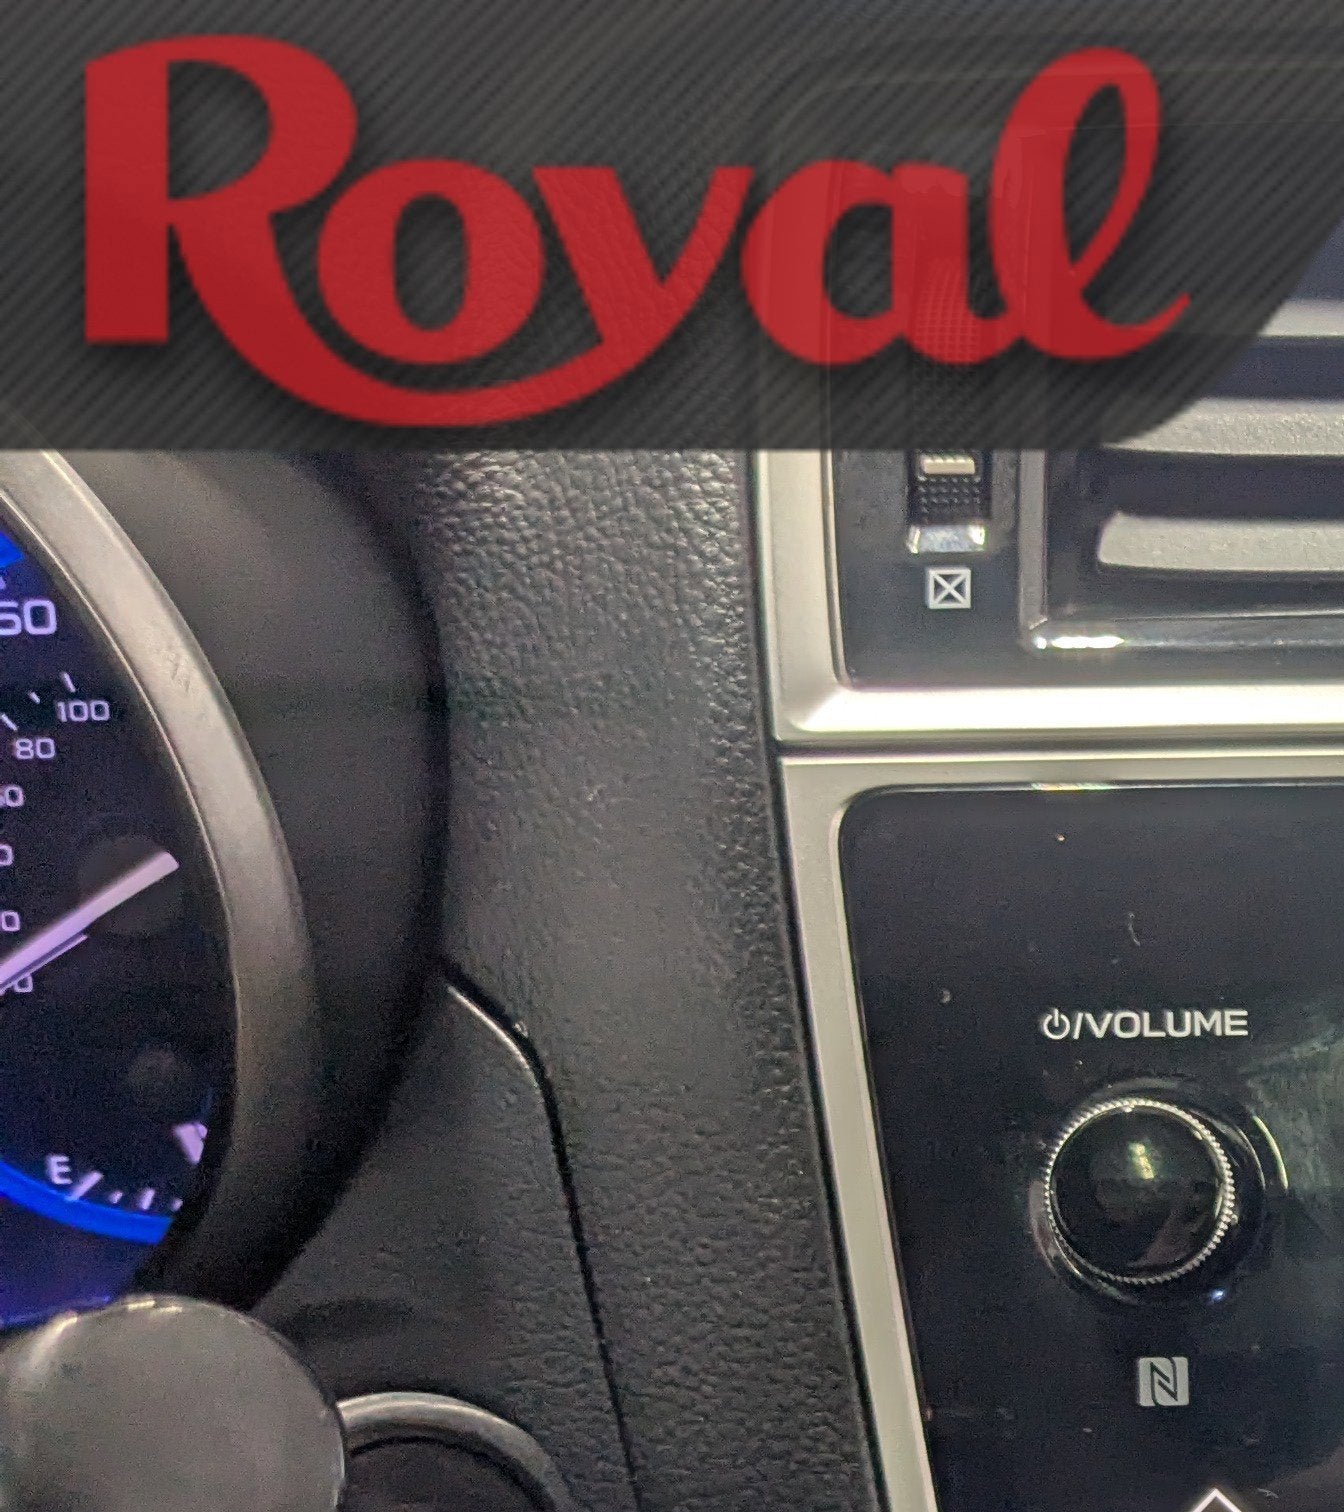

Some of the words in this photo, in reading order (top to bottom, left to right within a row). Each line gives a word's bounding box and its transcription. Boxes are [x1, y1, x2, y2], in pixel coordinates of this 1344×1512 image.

[57, 700, 110, 722] 100
[15, 738, 56, 759] 80
[47, 1154, 72, 1184] E
